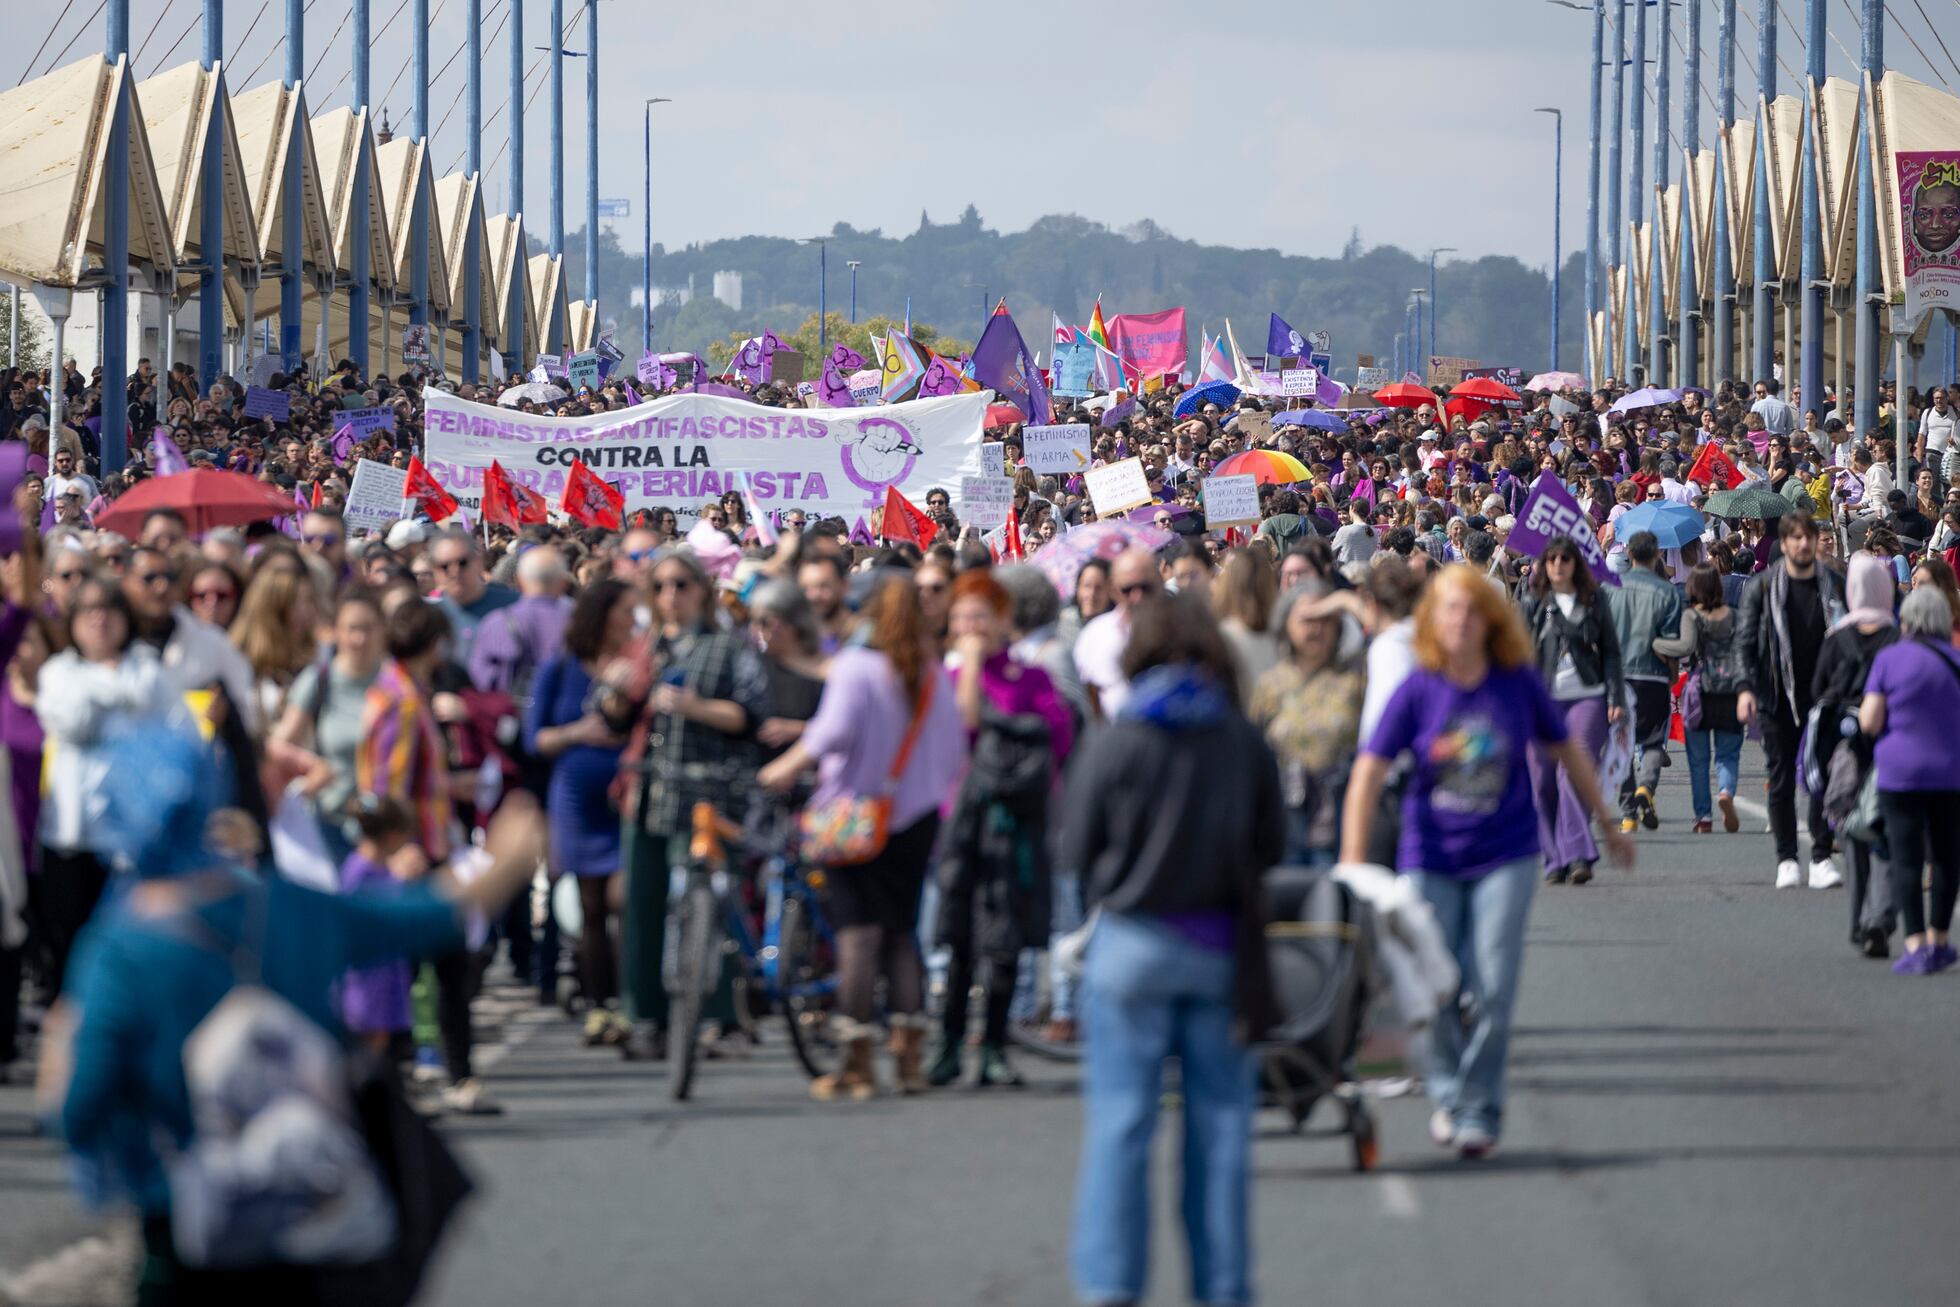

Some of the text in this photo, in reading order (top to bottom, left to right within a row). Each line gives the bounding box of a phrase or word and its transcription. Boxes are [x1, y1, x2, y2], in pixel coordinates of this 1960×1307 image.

[853, 385, 879, 398] CUERPO
[426, 408, 593, 443] FEMINISTAS
[602, 415, 829, 441] ANTIFASCISTAS
[536, 446, 711, 468] CONTRA LA
[982, 445, 1002, 456] UCHA
[1026, 451, 1071, 464] MI ARMA
[602, 469, 829, 499] PERIALSTA
